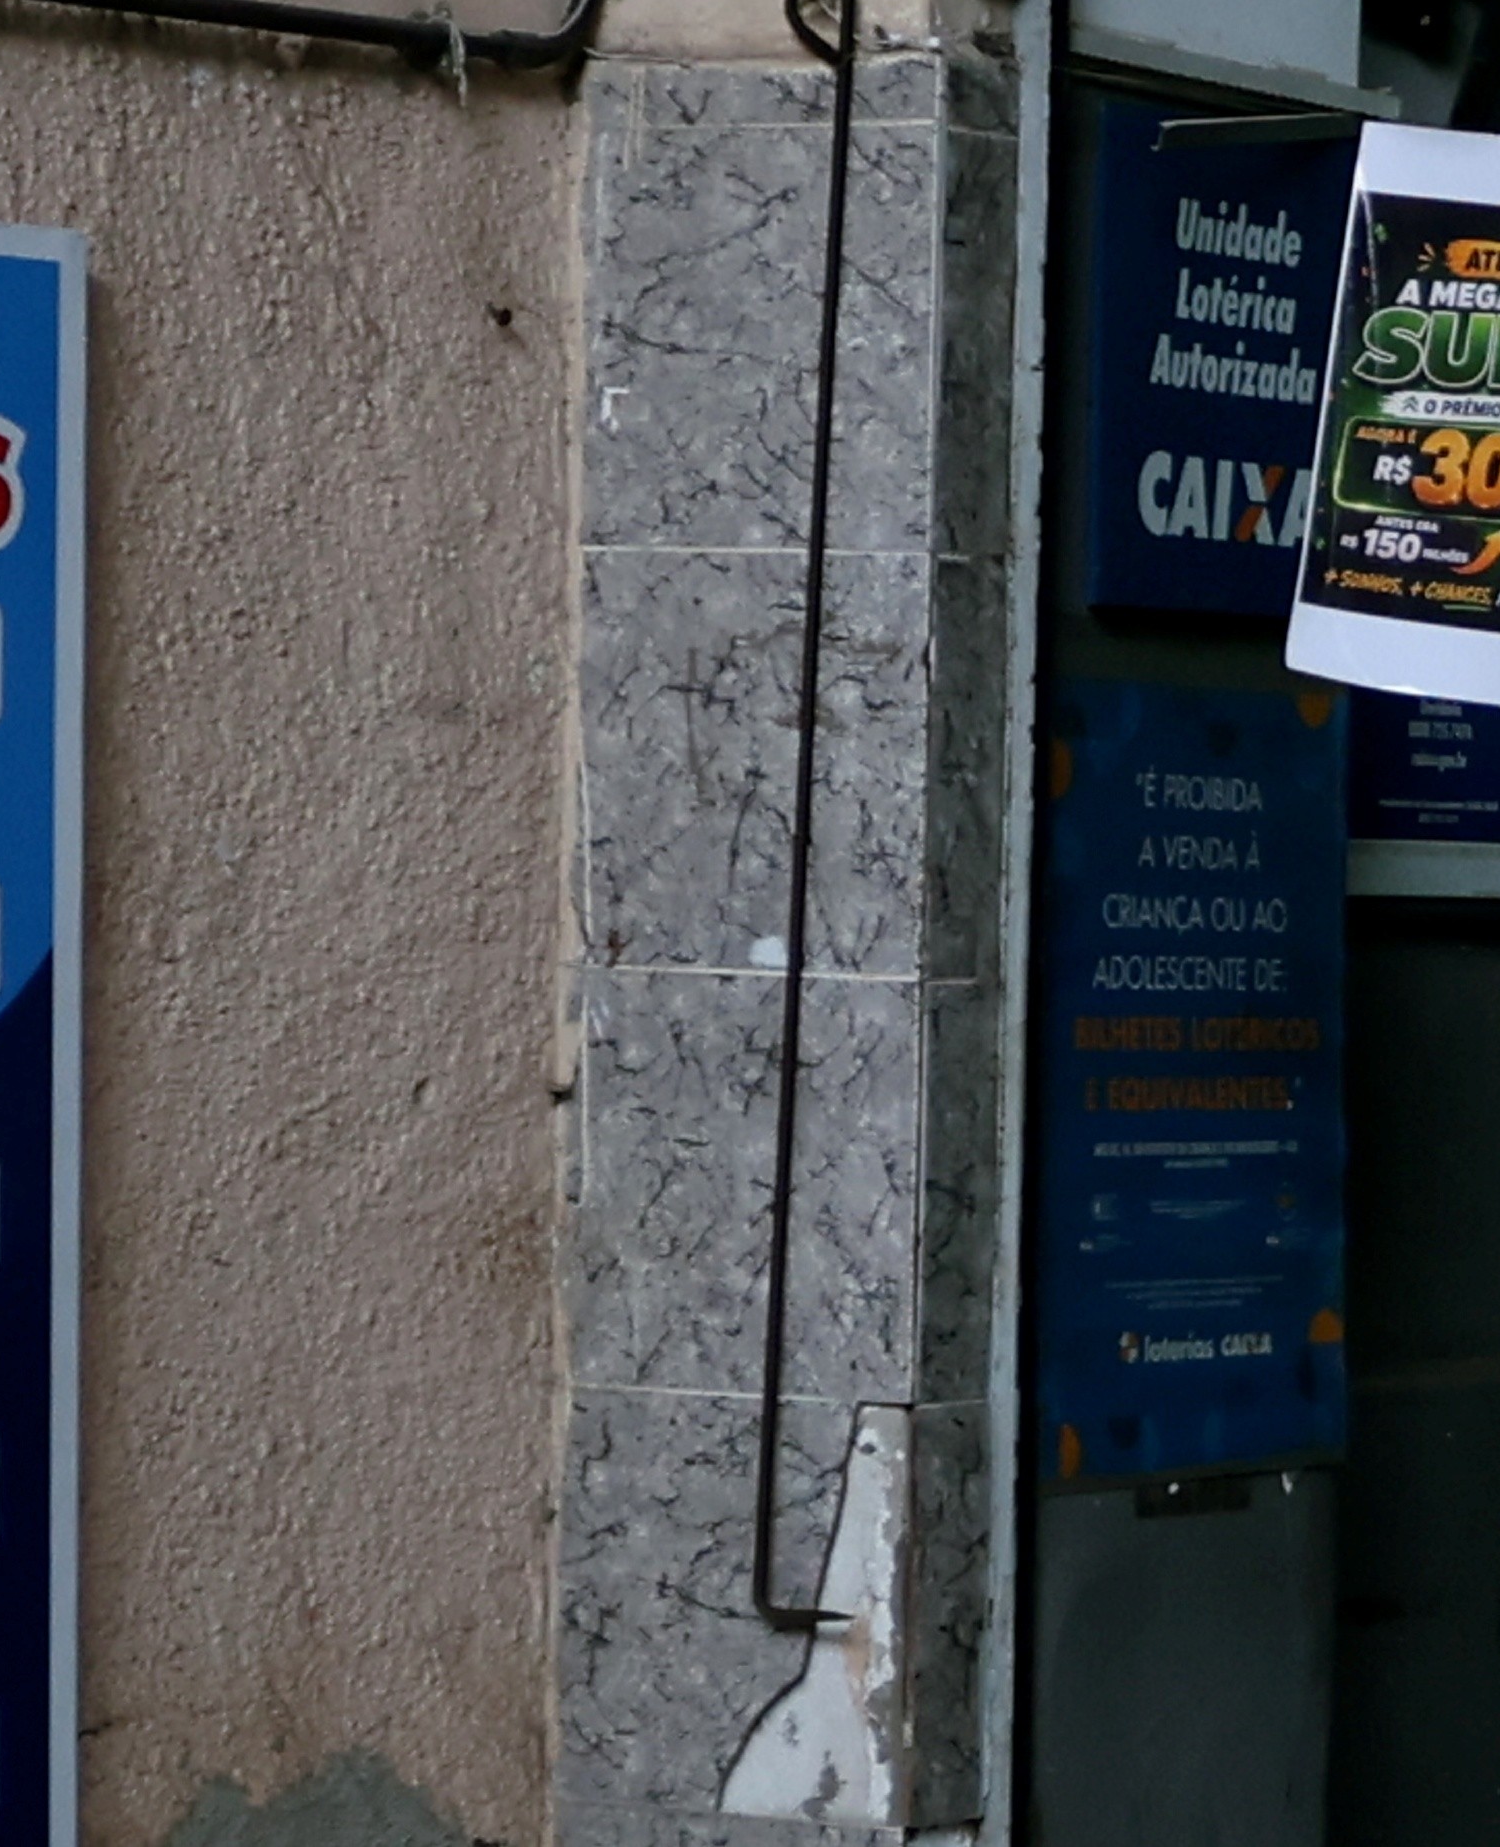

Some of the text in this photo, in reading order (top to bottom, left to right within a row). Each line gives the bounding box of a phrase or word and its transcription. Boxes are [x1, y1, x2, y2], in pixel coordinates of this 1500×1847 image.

[1177, 197, 1301, 266] Unidade
[1176, 269, 1295, 335] Lotérica
[1396, 279, 1420, 305] A
[1150, 333, 1316, 404] Autorizada
[1424, 400, 1436, 415] O
[1440, 397, 1500, 417] PRÊMIO
[1373, 454, 1411, 485] R$
[1138, 451, 1310, 548] CAIXA
[1363, 527, 1423, 563] 150
[1164, 773, 1263, 812] PROIBIDA
[1138, 835, 1155, 868] A
[1163, 835, 1239, 871] VENDA
[1103, 892, 1289, 936] CRIANÇA OU AO
[1092, 954, 1247, 991] ADOLESCENTE
